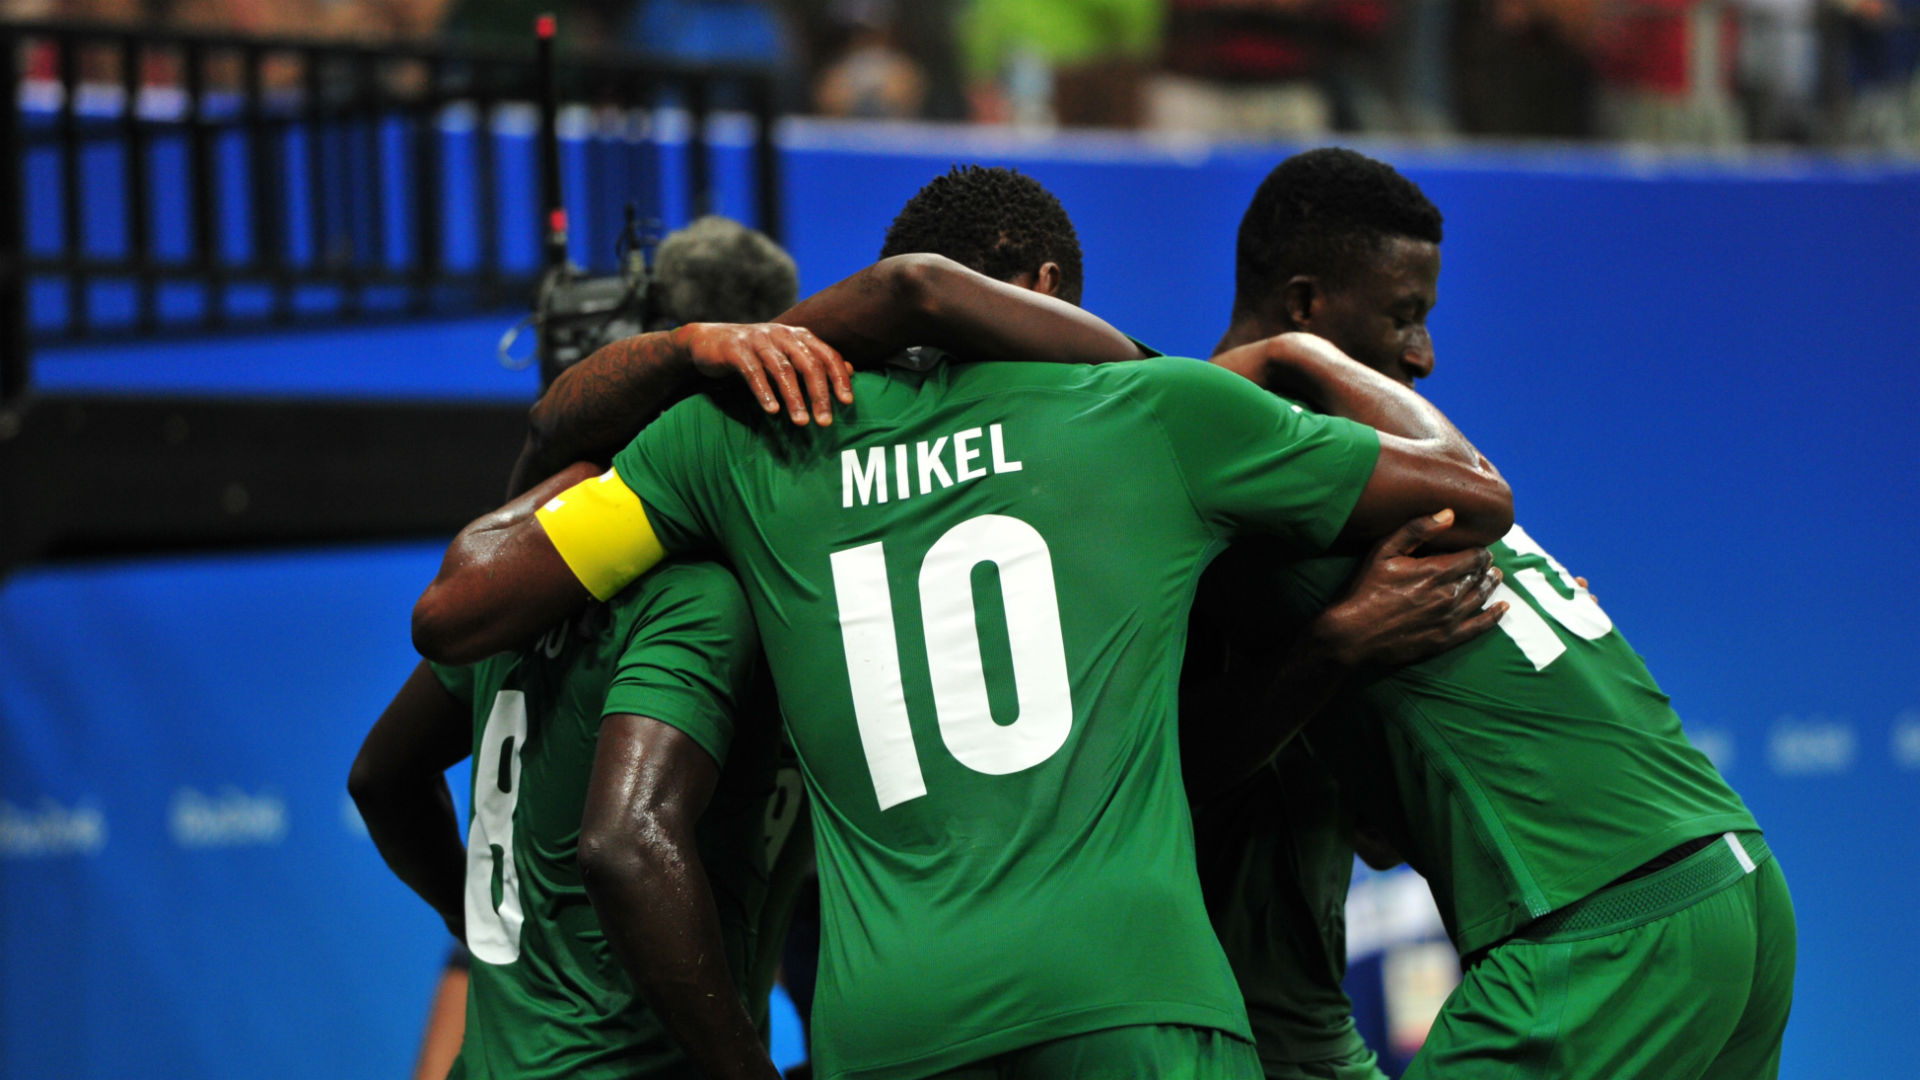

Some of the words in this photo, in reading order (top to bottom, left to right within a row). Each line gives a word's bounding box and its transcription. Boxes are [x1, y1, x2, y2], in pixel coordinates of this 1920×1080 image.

[841, 424, 1023, 508] MIKEL
[829, 513, 1074, 812] 10
[464, 690, 527, 966] 8
